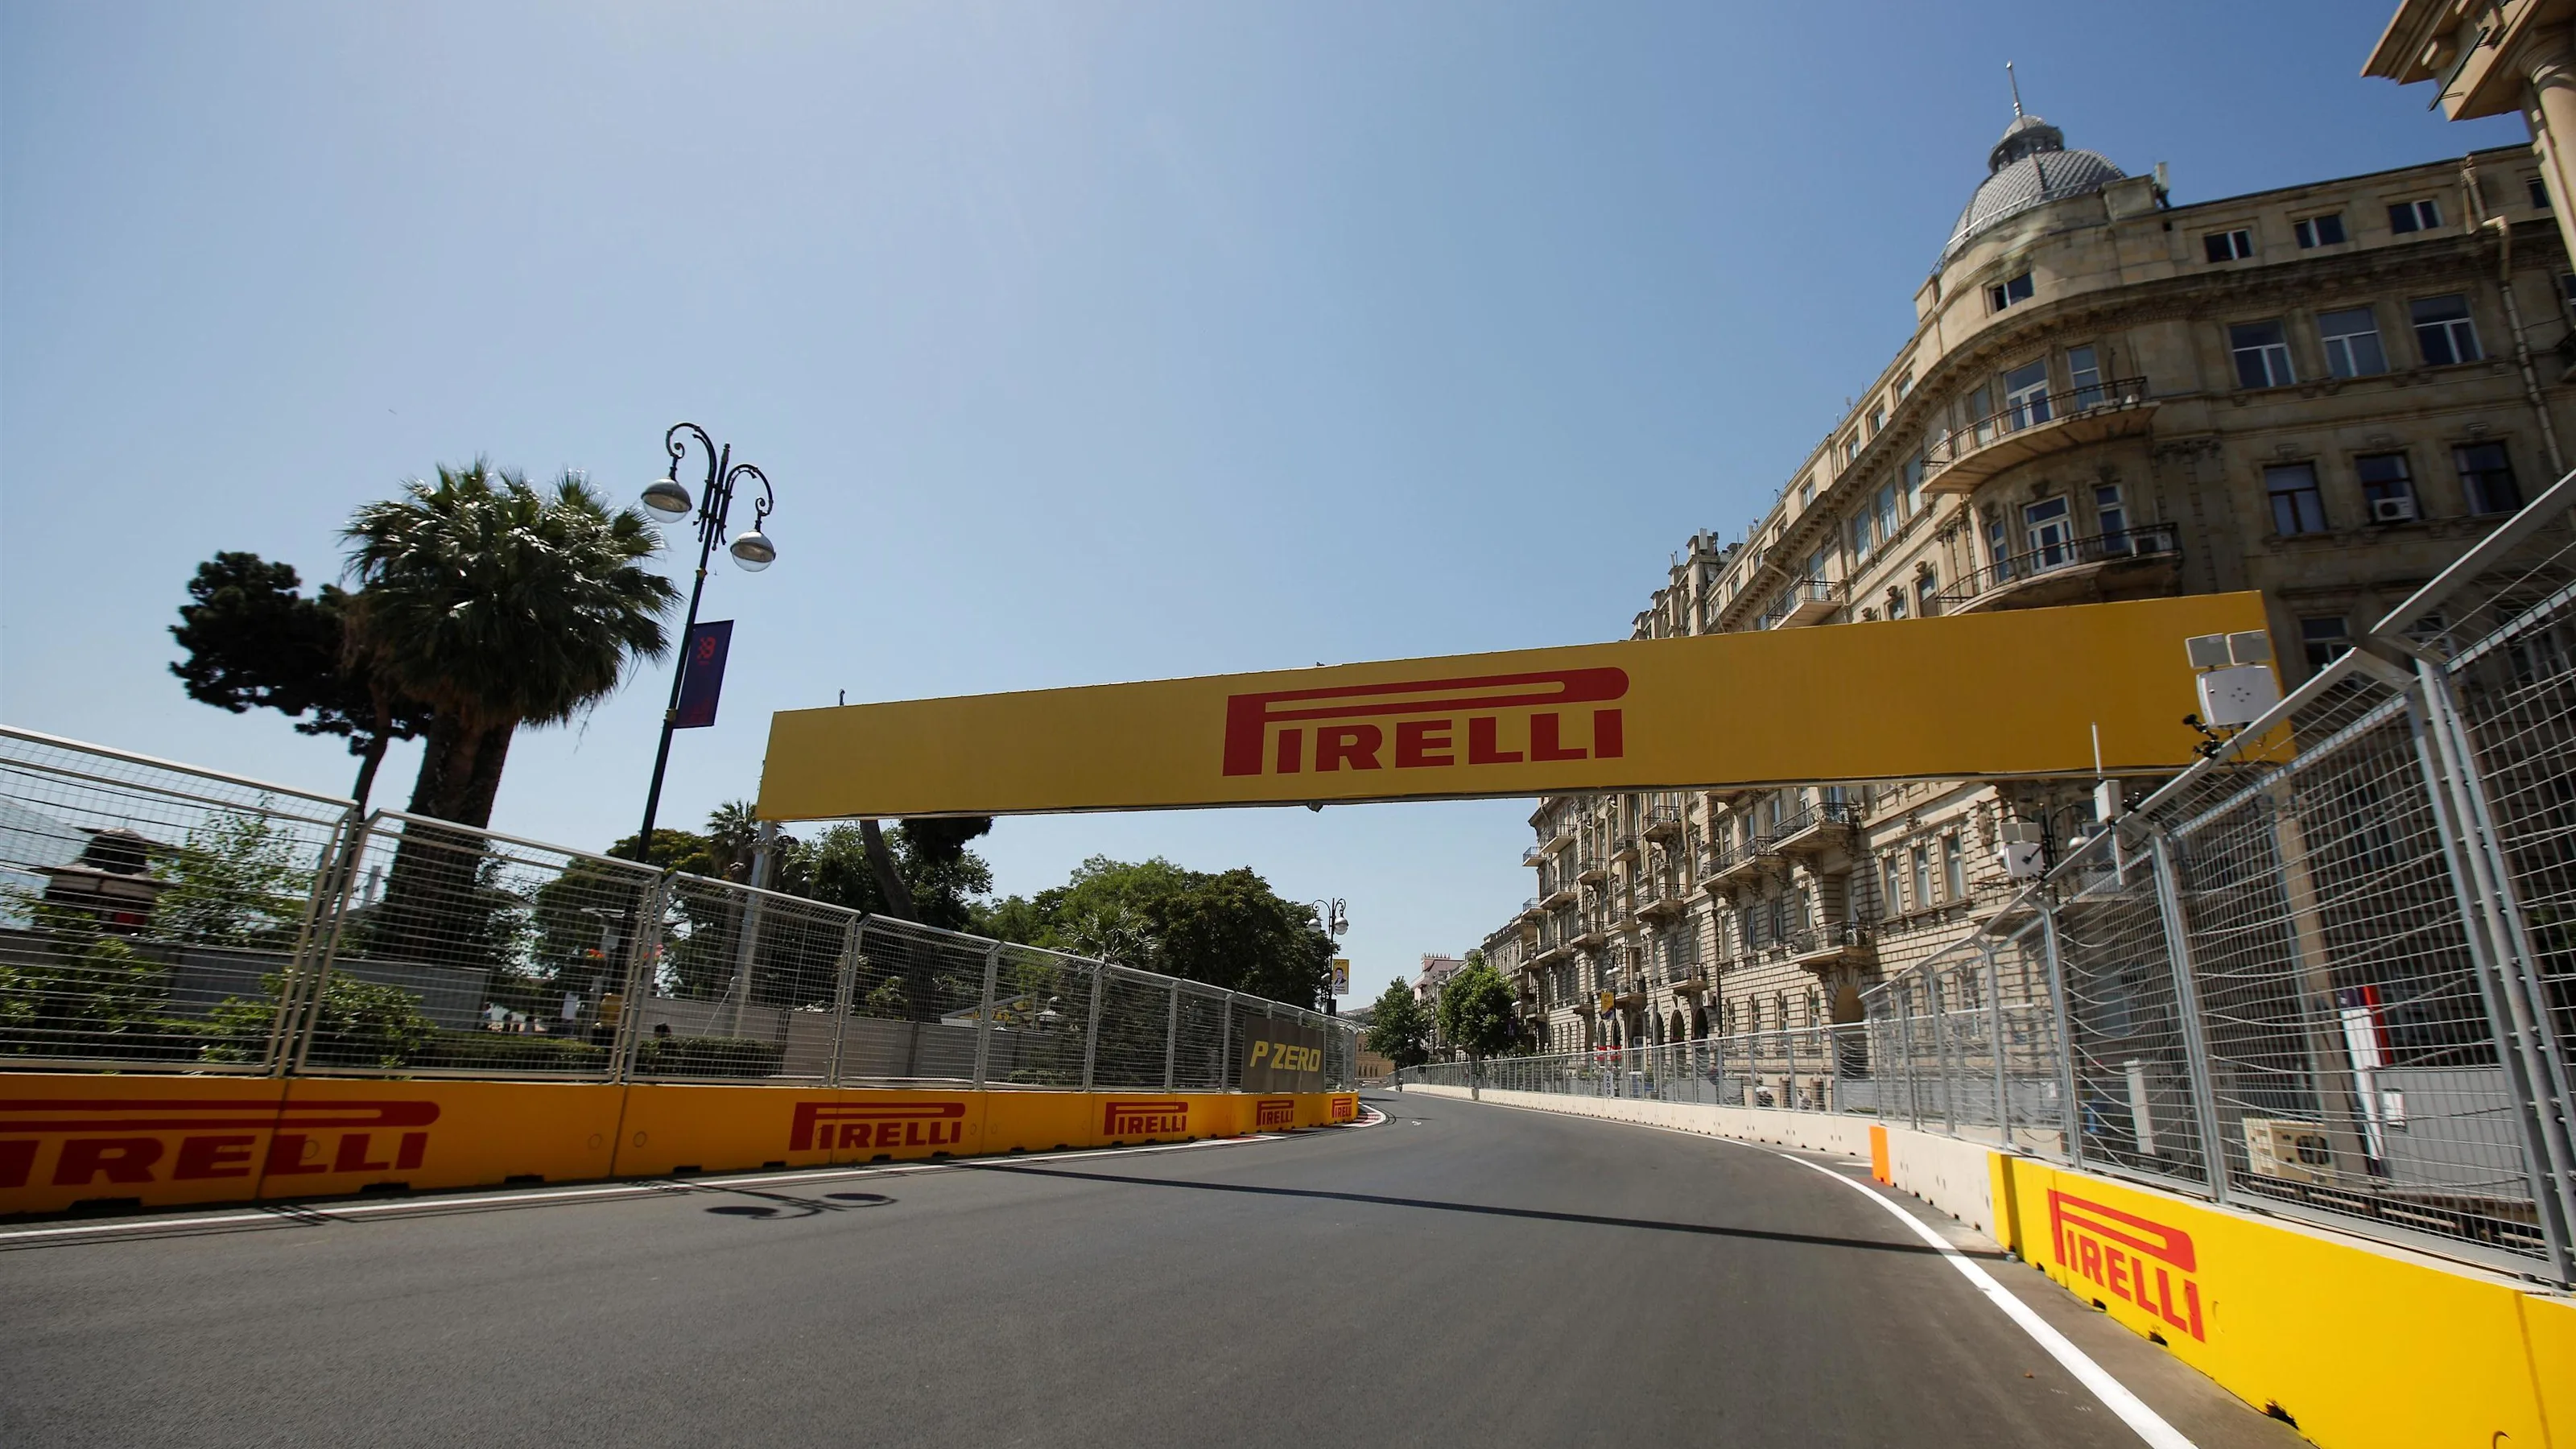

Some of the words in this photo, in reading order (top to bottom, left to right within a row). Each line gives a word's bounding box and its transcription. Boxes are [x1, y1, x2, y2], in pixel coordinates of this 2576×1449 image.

[1223, 667, 1629, 777] PIRELLI
[1249, 1040, 1269, 1067] P
[1270, 1042, 1321, 1072] ZERO
[789, 1102, 966, 1151] PIRELLI
[1104, 1101, 1189, 1136] PIRELLI
[1256, 1100, 1294, 1126] PIRELLI
[2048, 1189, 2206, 1343] PIRELLI
